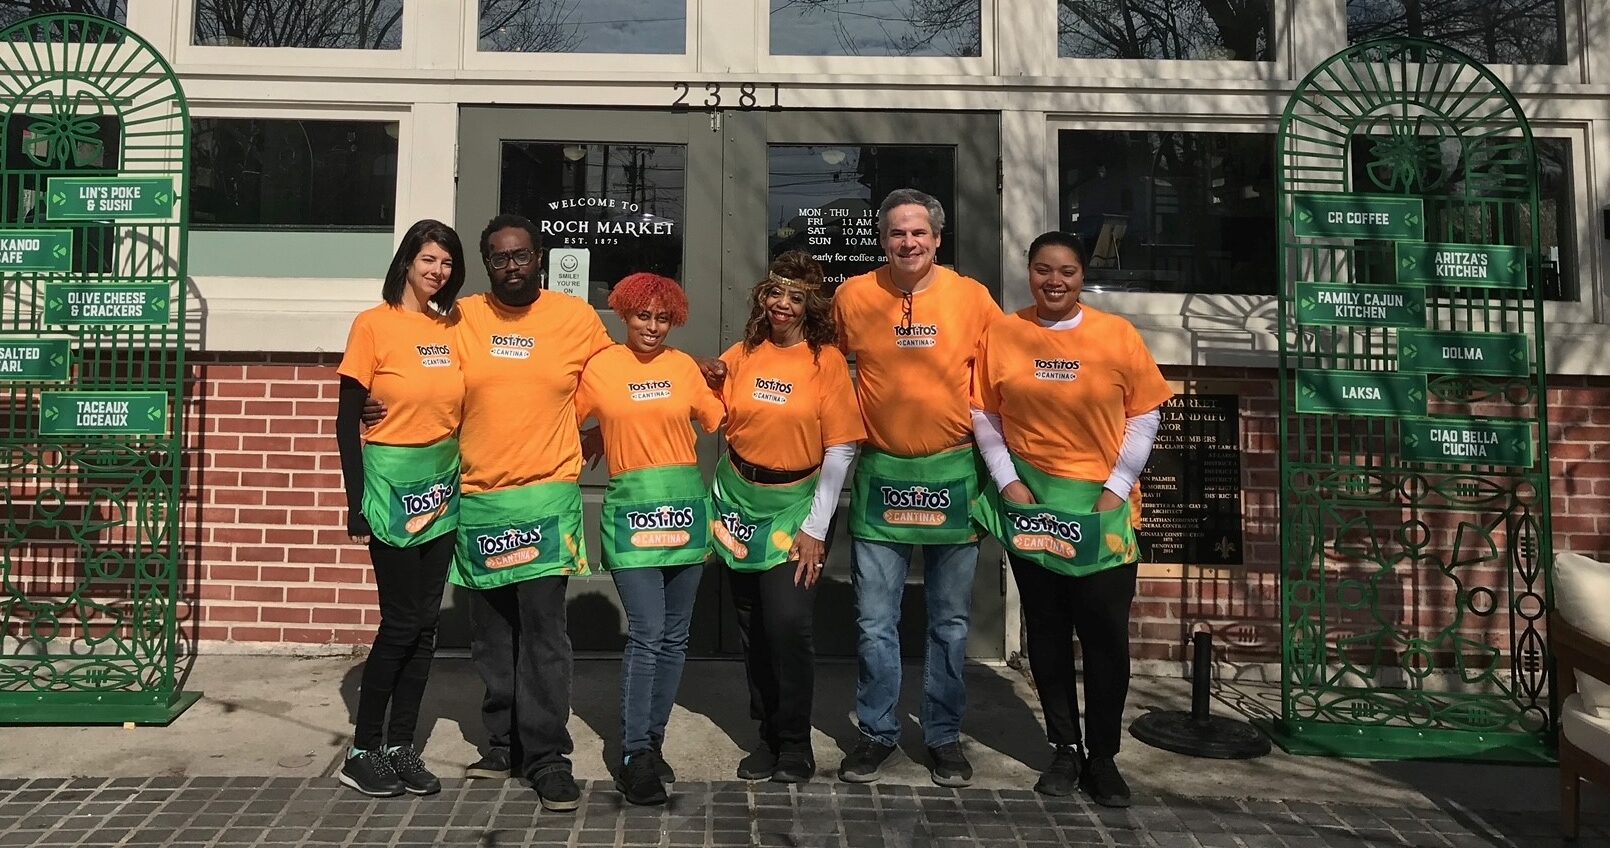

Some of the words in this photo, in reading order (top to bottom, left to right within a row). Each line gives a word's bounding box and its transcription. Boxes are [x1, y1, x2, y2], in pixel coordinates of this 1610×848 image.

[672, 81, 783, 108] 2381
[80, 187, 108, 199] LIN'S
[111, 187, 141, 199] POKE
[87, 201, 95, 211] &
[100, 201, 132, 211] SUSHI
[548, 198, 616, 210] WELCOME
[621, 201, 639, 212] TO
[798, 208, 821, 216] MON
[829, 208, 849, 217] THU
[863, 209, 872, 217] 11
[1328, 211, 1344, 224] CR
[1346, 212, 1389, 225] COFFEE
[807, 218, 823, 226] FRI
[855, 218, 872, 226] AM
[541, 220, 589, 236] ROCH
[597, 221, 674, 237] MARKET
[807, 227, 826, 235] SAT
[808, 237, 831, 245] SUN
[0, 251, 23, 264] AFE
[812, 253, 832, 263] early
[835, 253, 847, 261] for
[849, 253, 874, 262] coffee
[1435, 252, 1488, 265] ARITZA'S
[1436, 265, 1487, 278] KITCHEN
[68, 292, 100, 304] OLIVE
[104, 292, 146, 304] CHEESE
[1318, 292, 1360, 305] FAMILY
[1364, 293, 1403, 307] CAJUN
[71, 306, 79, 317] &
[83, 306, 143, 317] CRACKERS
[1335, 305, 1386, 319] KITCHEN
[1442, 347, 1483, 360] DOLMA
[0, 360, 23, 372] ARL
[1041, 372, 1070, 380] CANTINA
[637, 391, 665, 399] CANTINA
[757, 392, 781, 402] CANTINA
[1342, 386, 1381, 400] LAKSA
[77, 402, 129, 414] TACEAUX
[1167, 399, 1217, 407] MARKET
[77, 414, 128, 426] LOCEAUX
[1430, 429, 1458, 443] CIAO
[1462, 430, 1498, 444] BELLA
[1442, 443, 1486, 456] CUCINA
[893, 512, 935, 523] CANTINA
[643, 532, 681, 545] CANTINA
[1023, 537, 1066, 555] CANTINA
[495, 550, 530, 566] CANTINA
